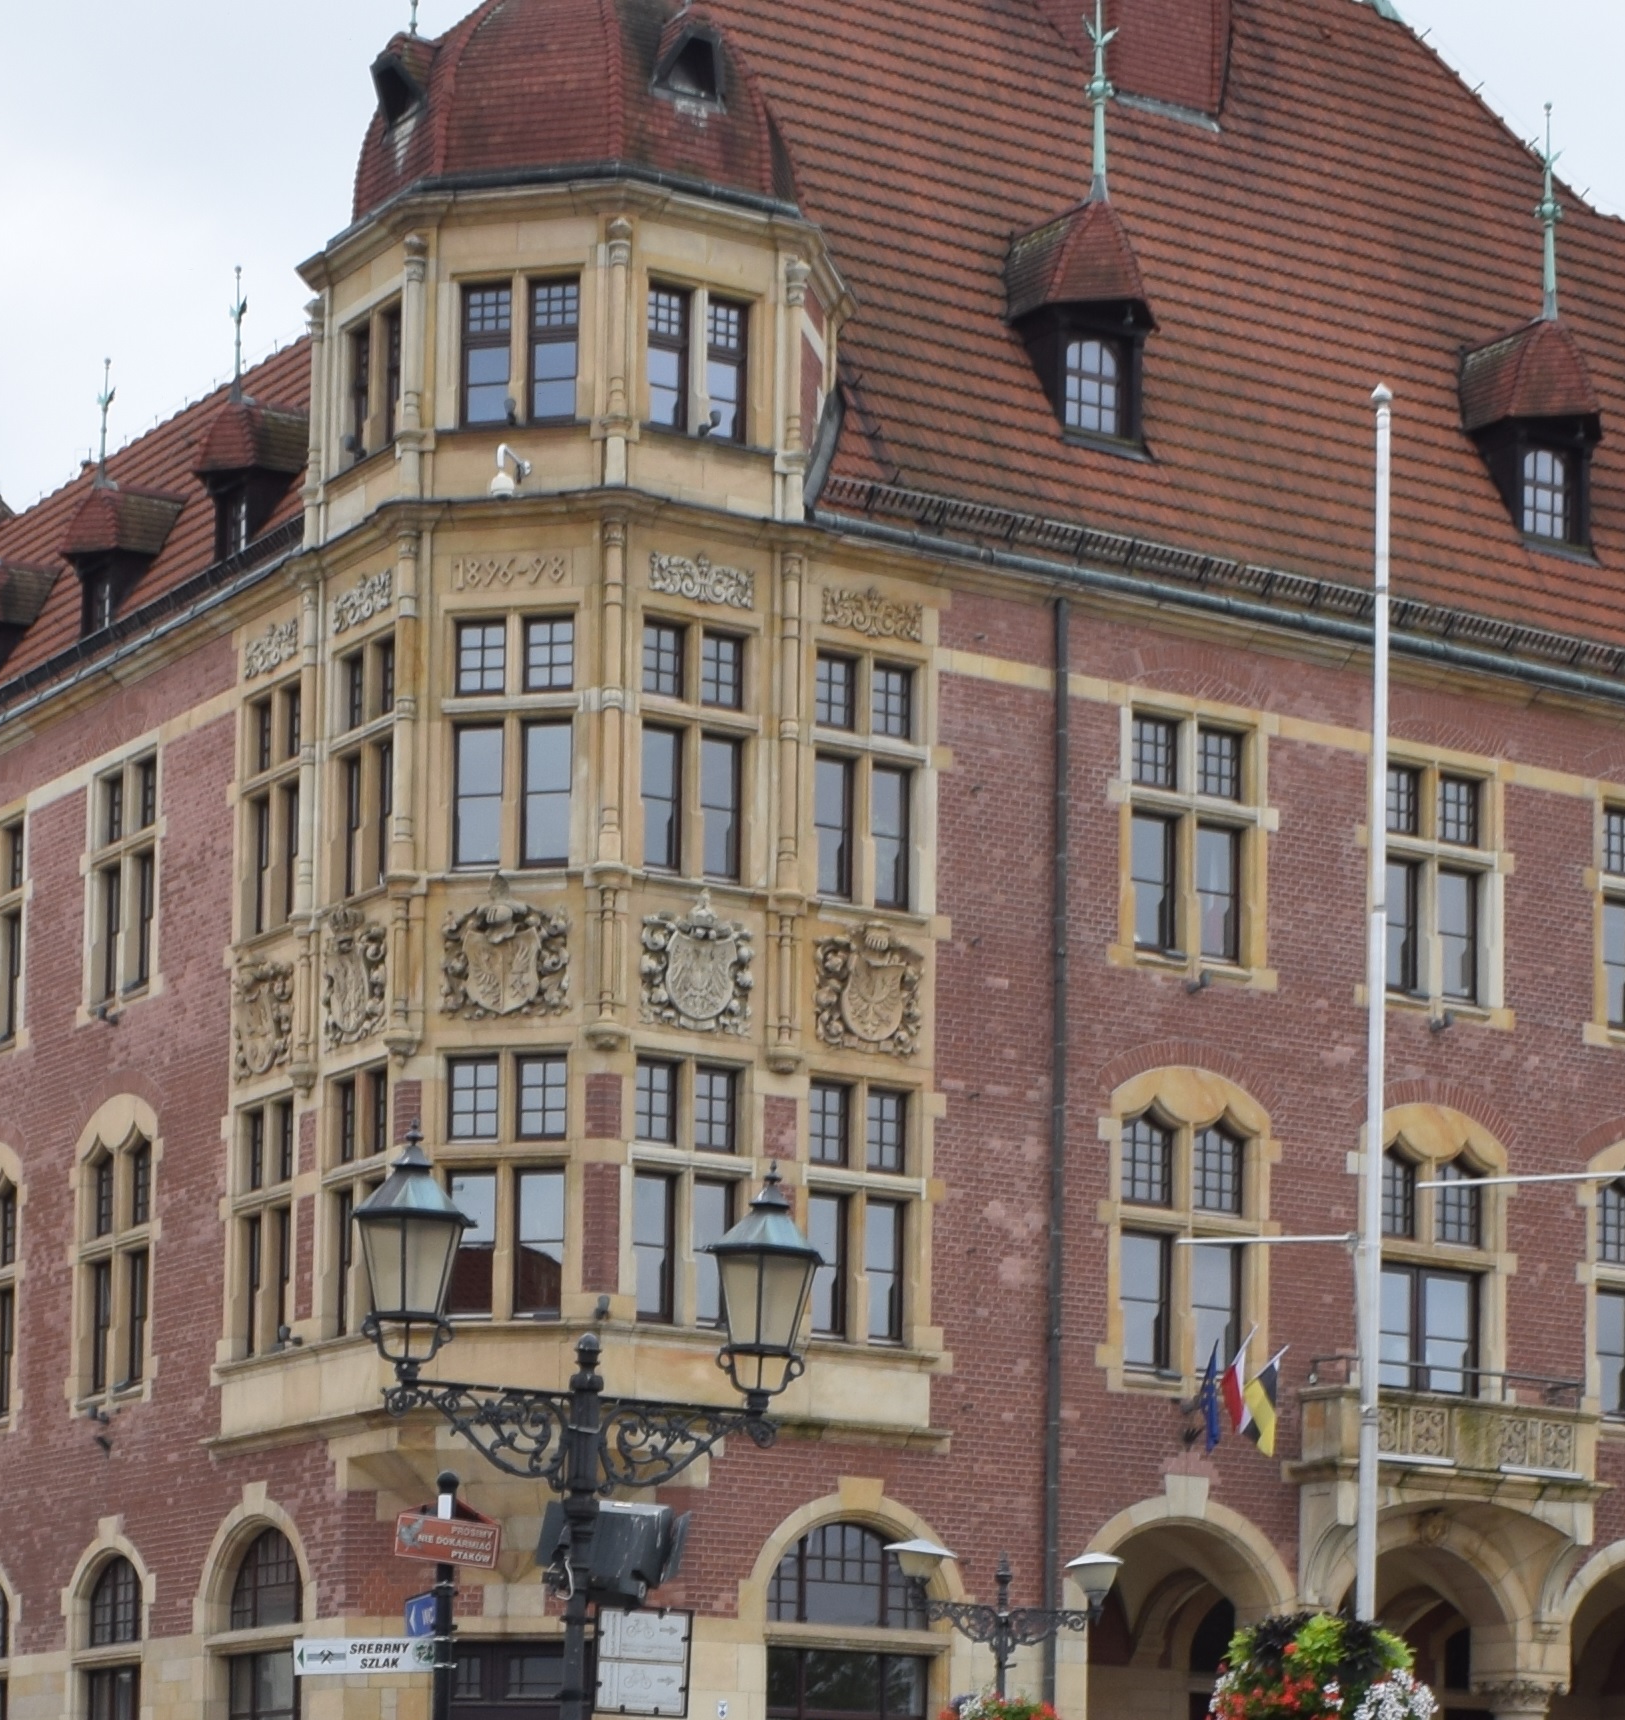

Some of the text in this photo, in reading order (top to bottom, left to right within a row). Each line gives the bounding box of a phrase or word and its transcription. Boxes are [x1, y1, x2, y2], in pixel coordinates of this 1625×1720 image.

[455, 556, 565, 591] 1896-98
[418, 1533, 434, 1545] NIE
[451, 1526, 494, 1539] PROSIMY
[450, 1550, 491, 1563] PTAKÓW
[349, 1642, 410, 1656] SREBRNY
[360, 1657, 400, 1670] SZLAK
